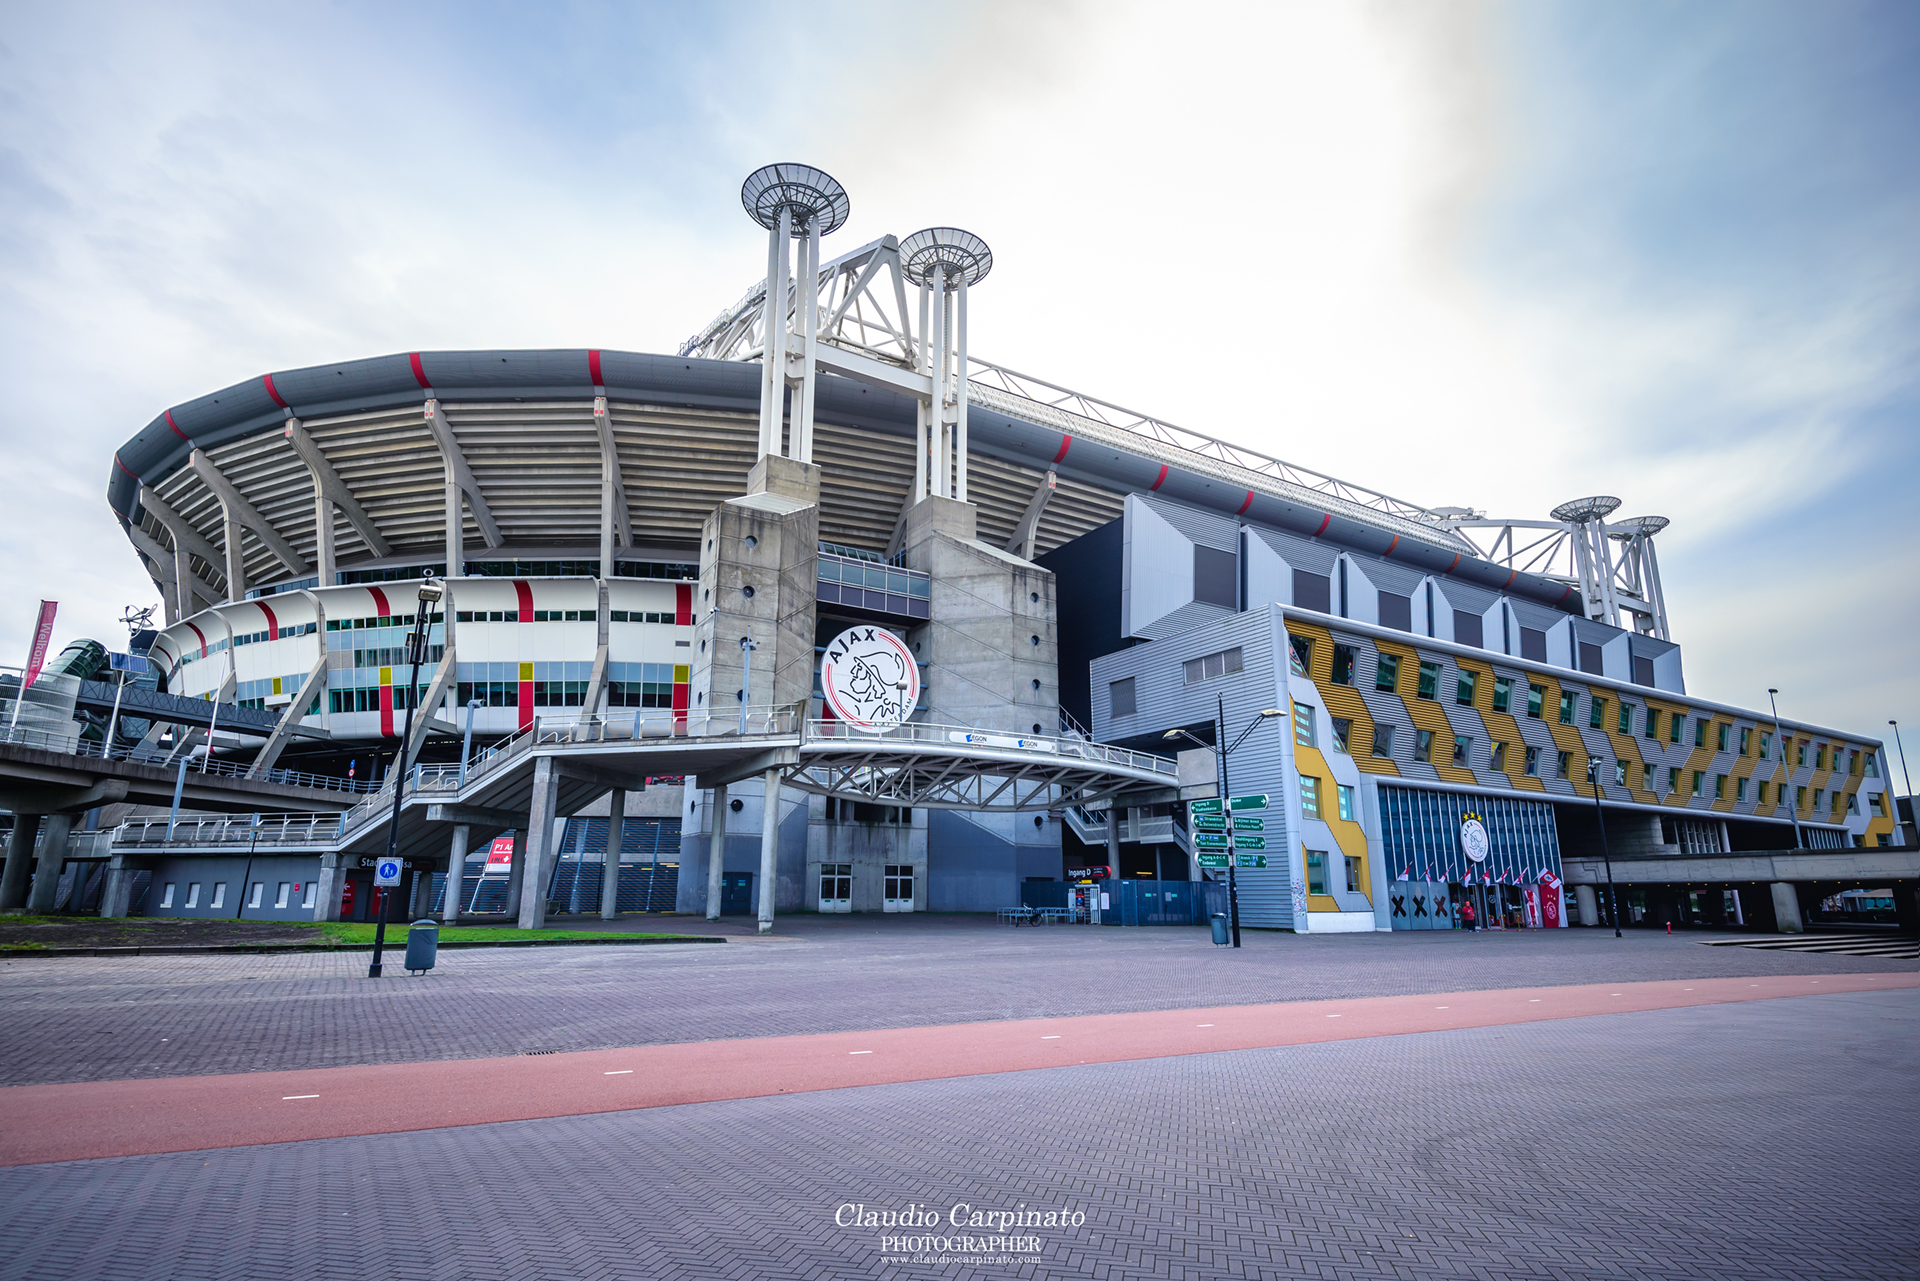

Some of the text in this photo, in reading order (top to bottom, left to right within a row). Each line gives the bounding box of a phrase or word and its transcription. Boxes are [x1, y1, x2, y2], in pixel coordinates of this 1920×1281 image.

[31, 623, 52, 667] Welkom
[829, 629, 876, 664] AJAX
[1463, 821, 1474, 838] AJAX
[1068, 869, 1086, 878] Ingang
[1086, 868, 1091, 876] D
